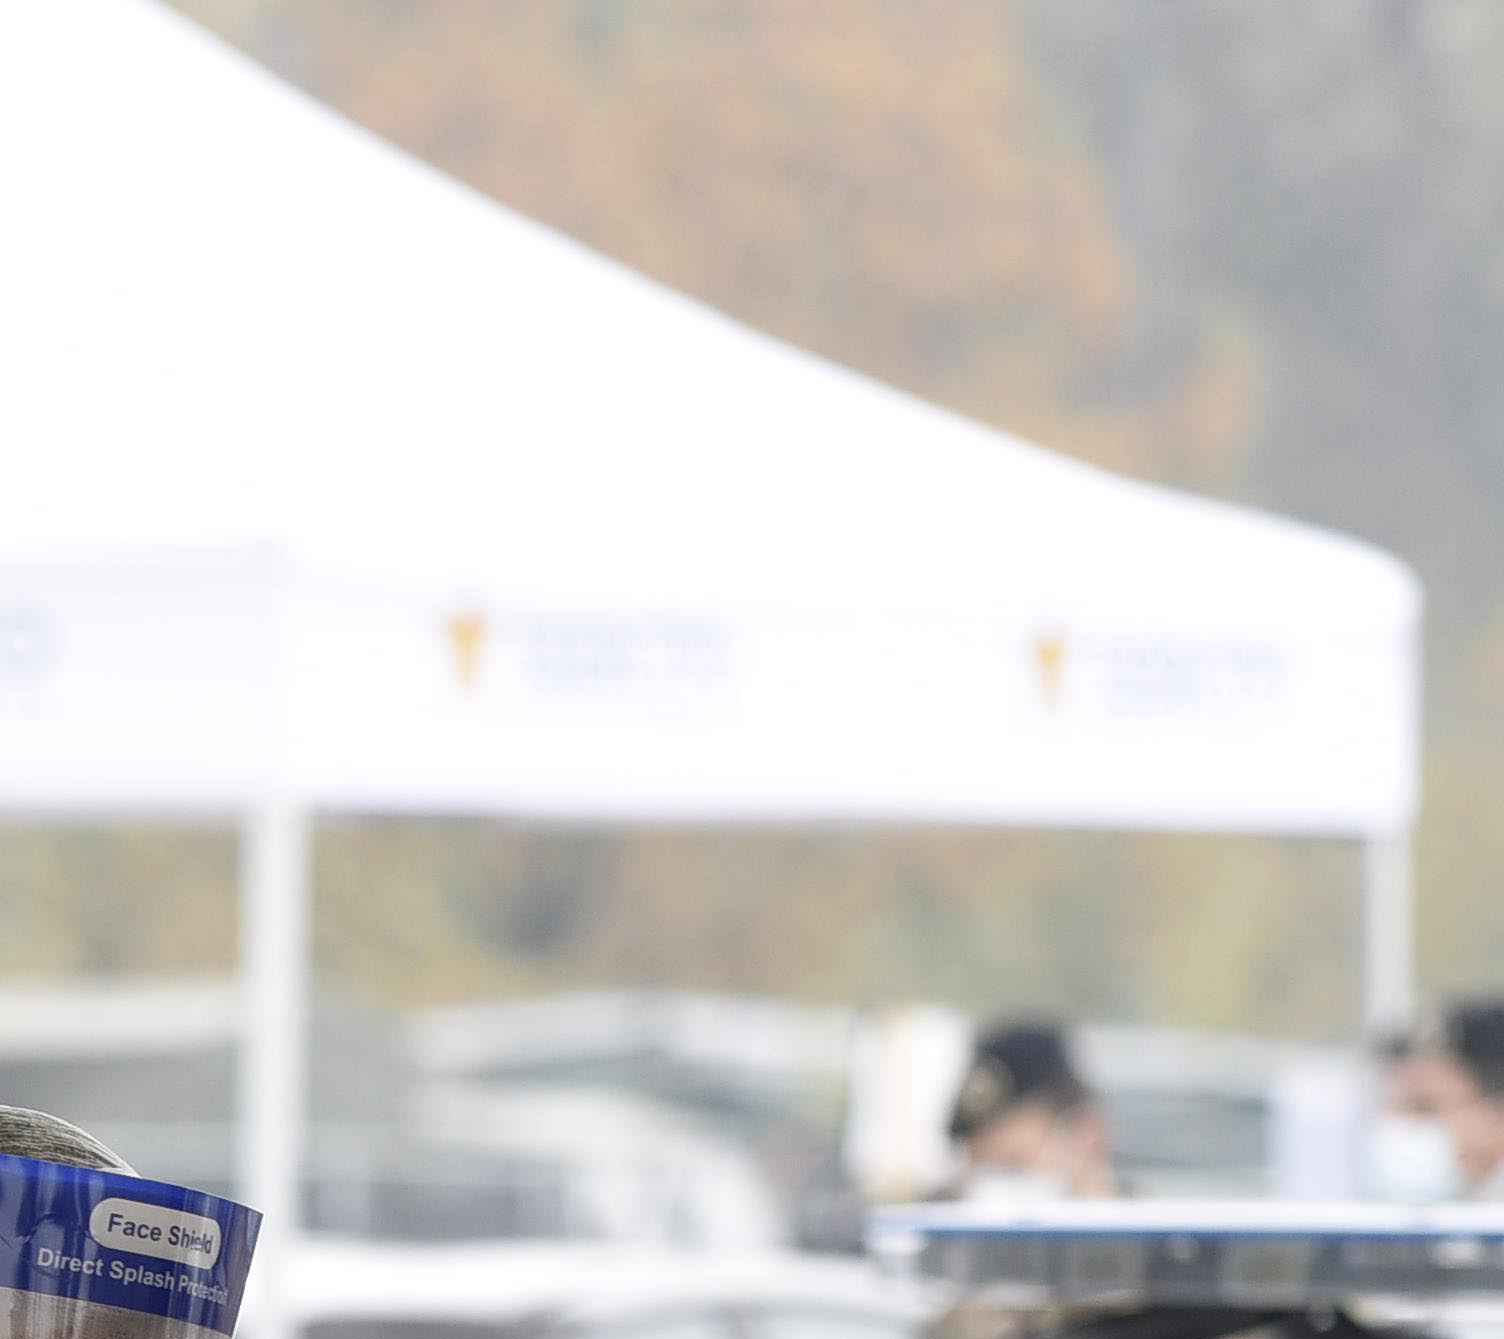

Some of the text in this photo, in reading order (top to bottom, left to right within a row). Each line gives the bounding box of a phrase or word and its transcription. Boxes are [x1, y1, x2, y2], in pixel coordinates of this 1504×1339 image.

[107, 1212, 214, 1255] Face Shield
[37, 1247, 228, 1306] Direct Splash Protection
